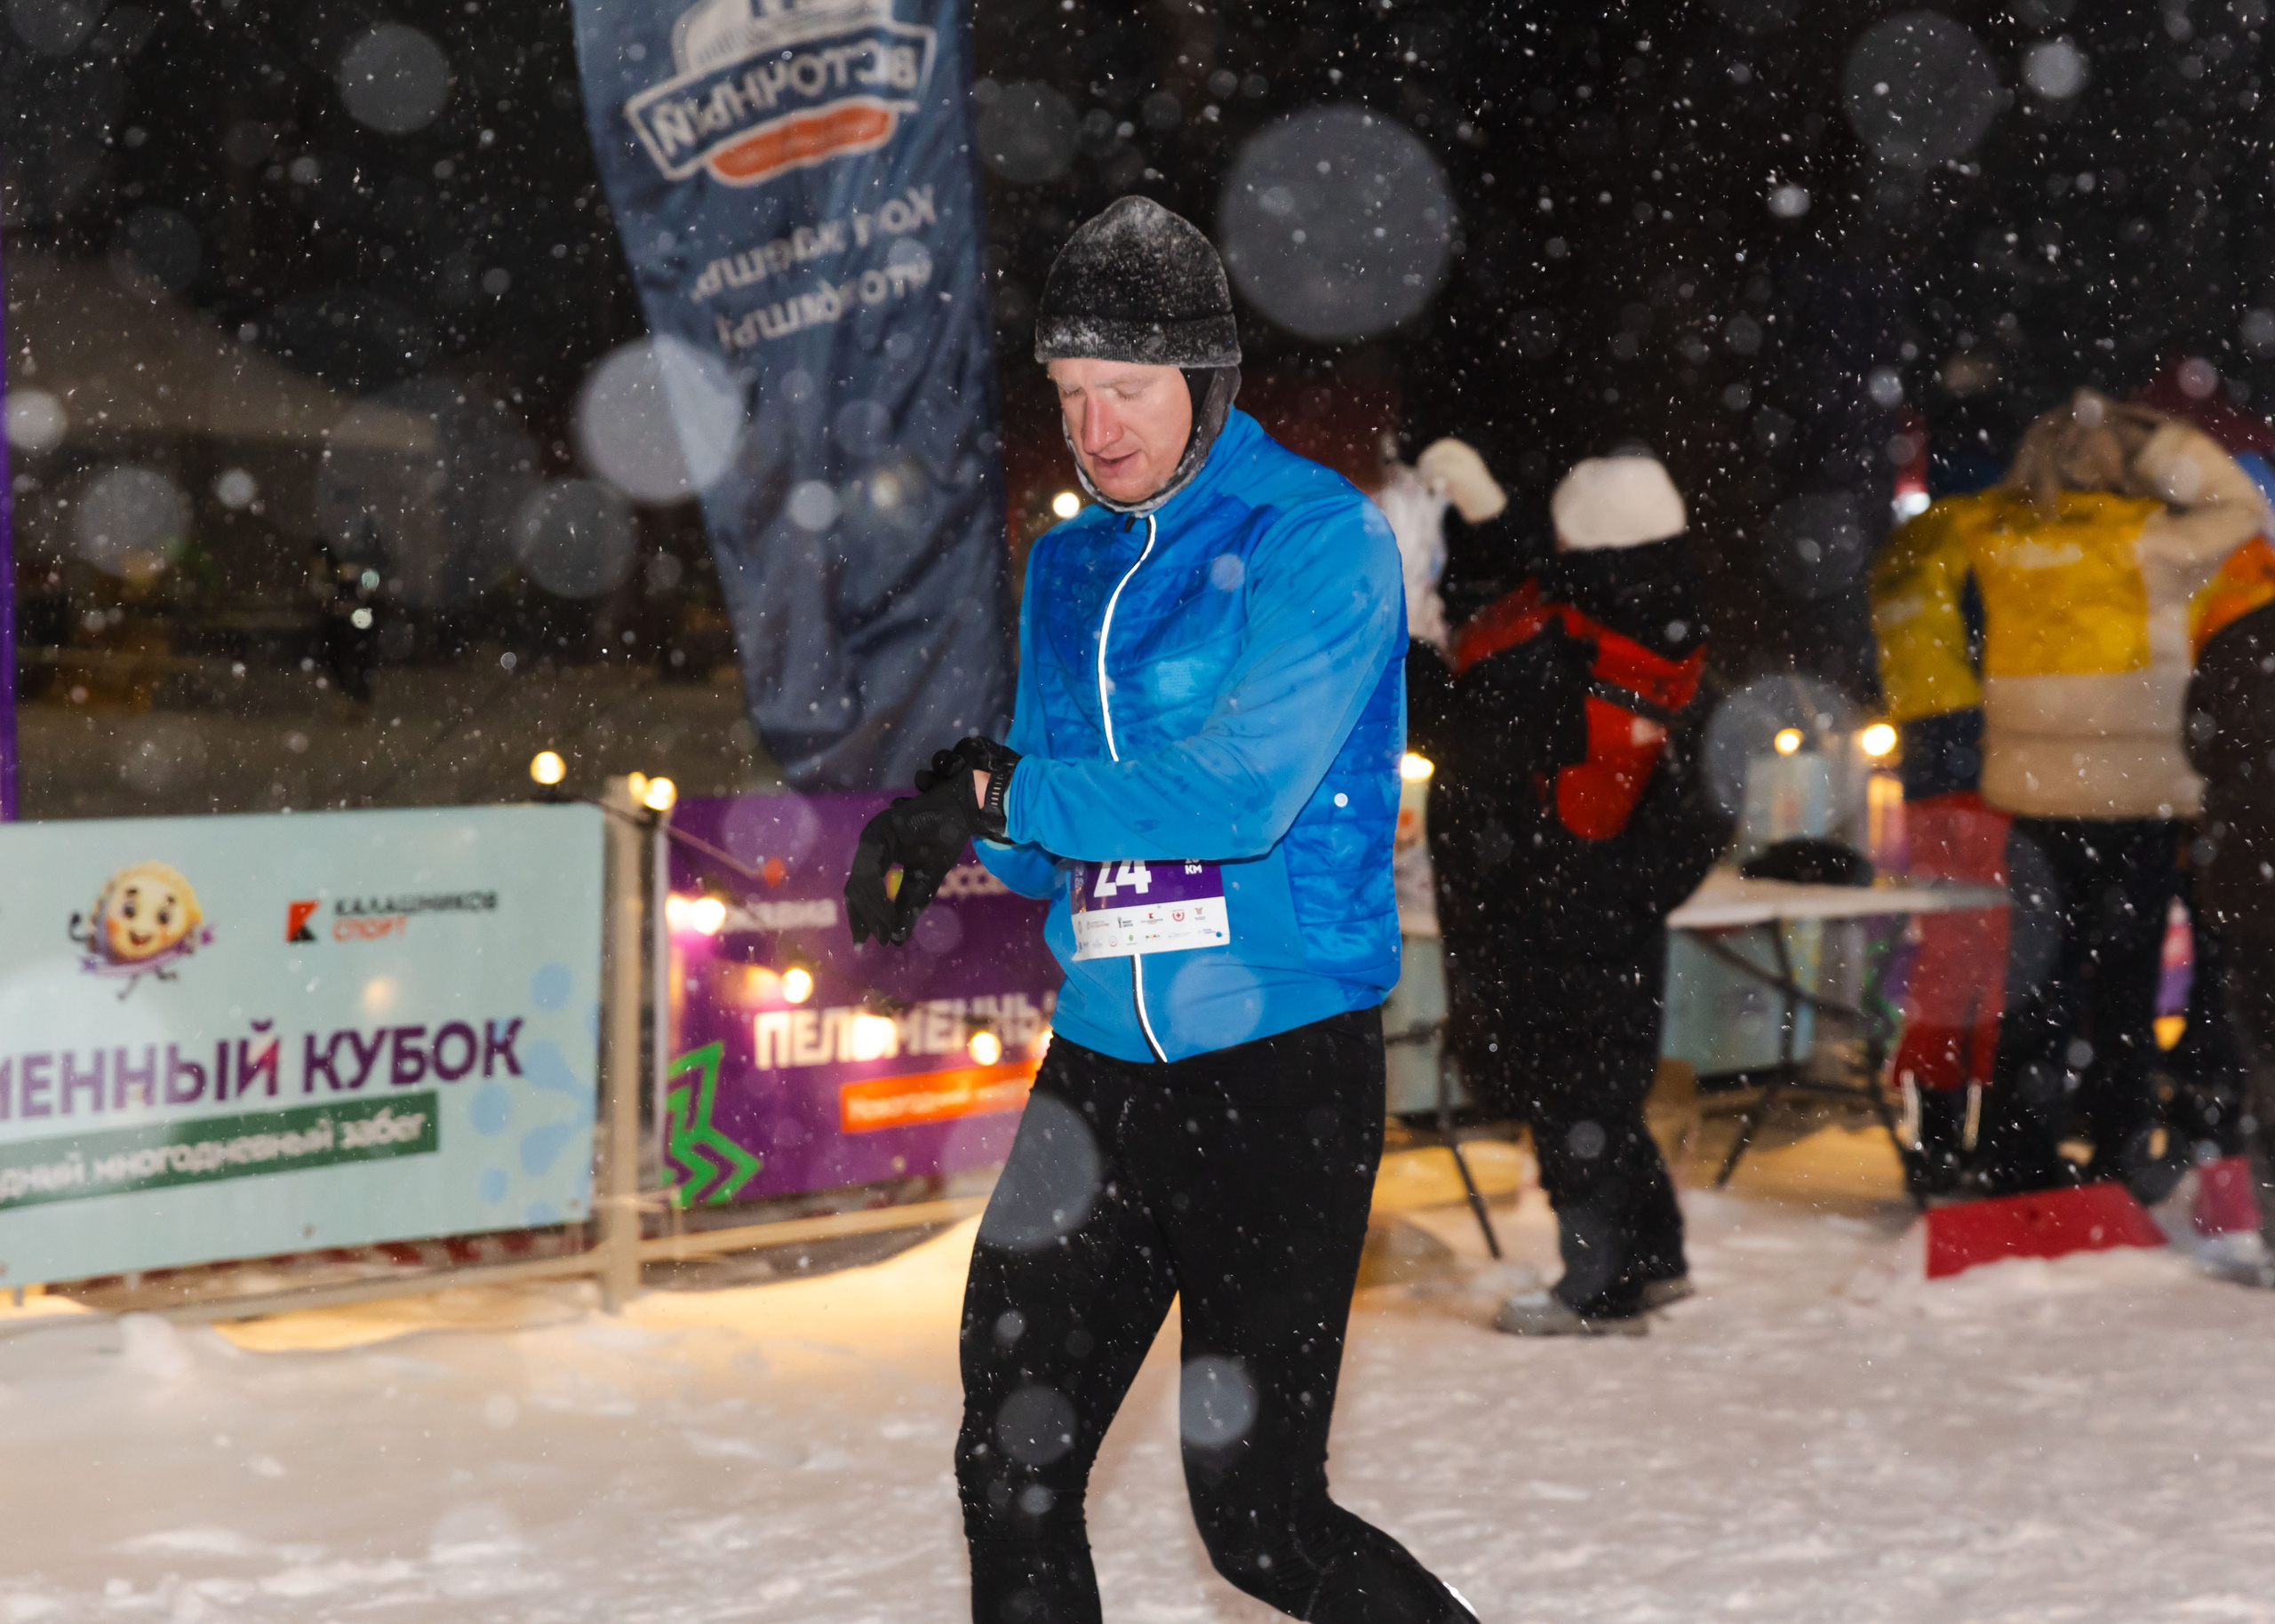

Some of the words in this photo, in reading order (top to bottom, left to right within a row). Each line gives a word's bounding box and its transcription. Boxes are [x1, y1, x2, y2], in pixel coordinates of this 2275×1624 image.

[333, 890, 498, 916] КАЛАШНИКОВ
[332, 914, 408, 943] СПОРТ
[302, 1018, 525, 1094] КУБОК
[339, 1107, 427, 1150] забег
